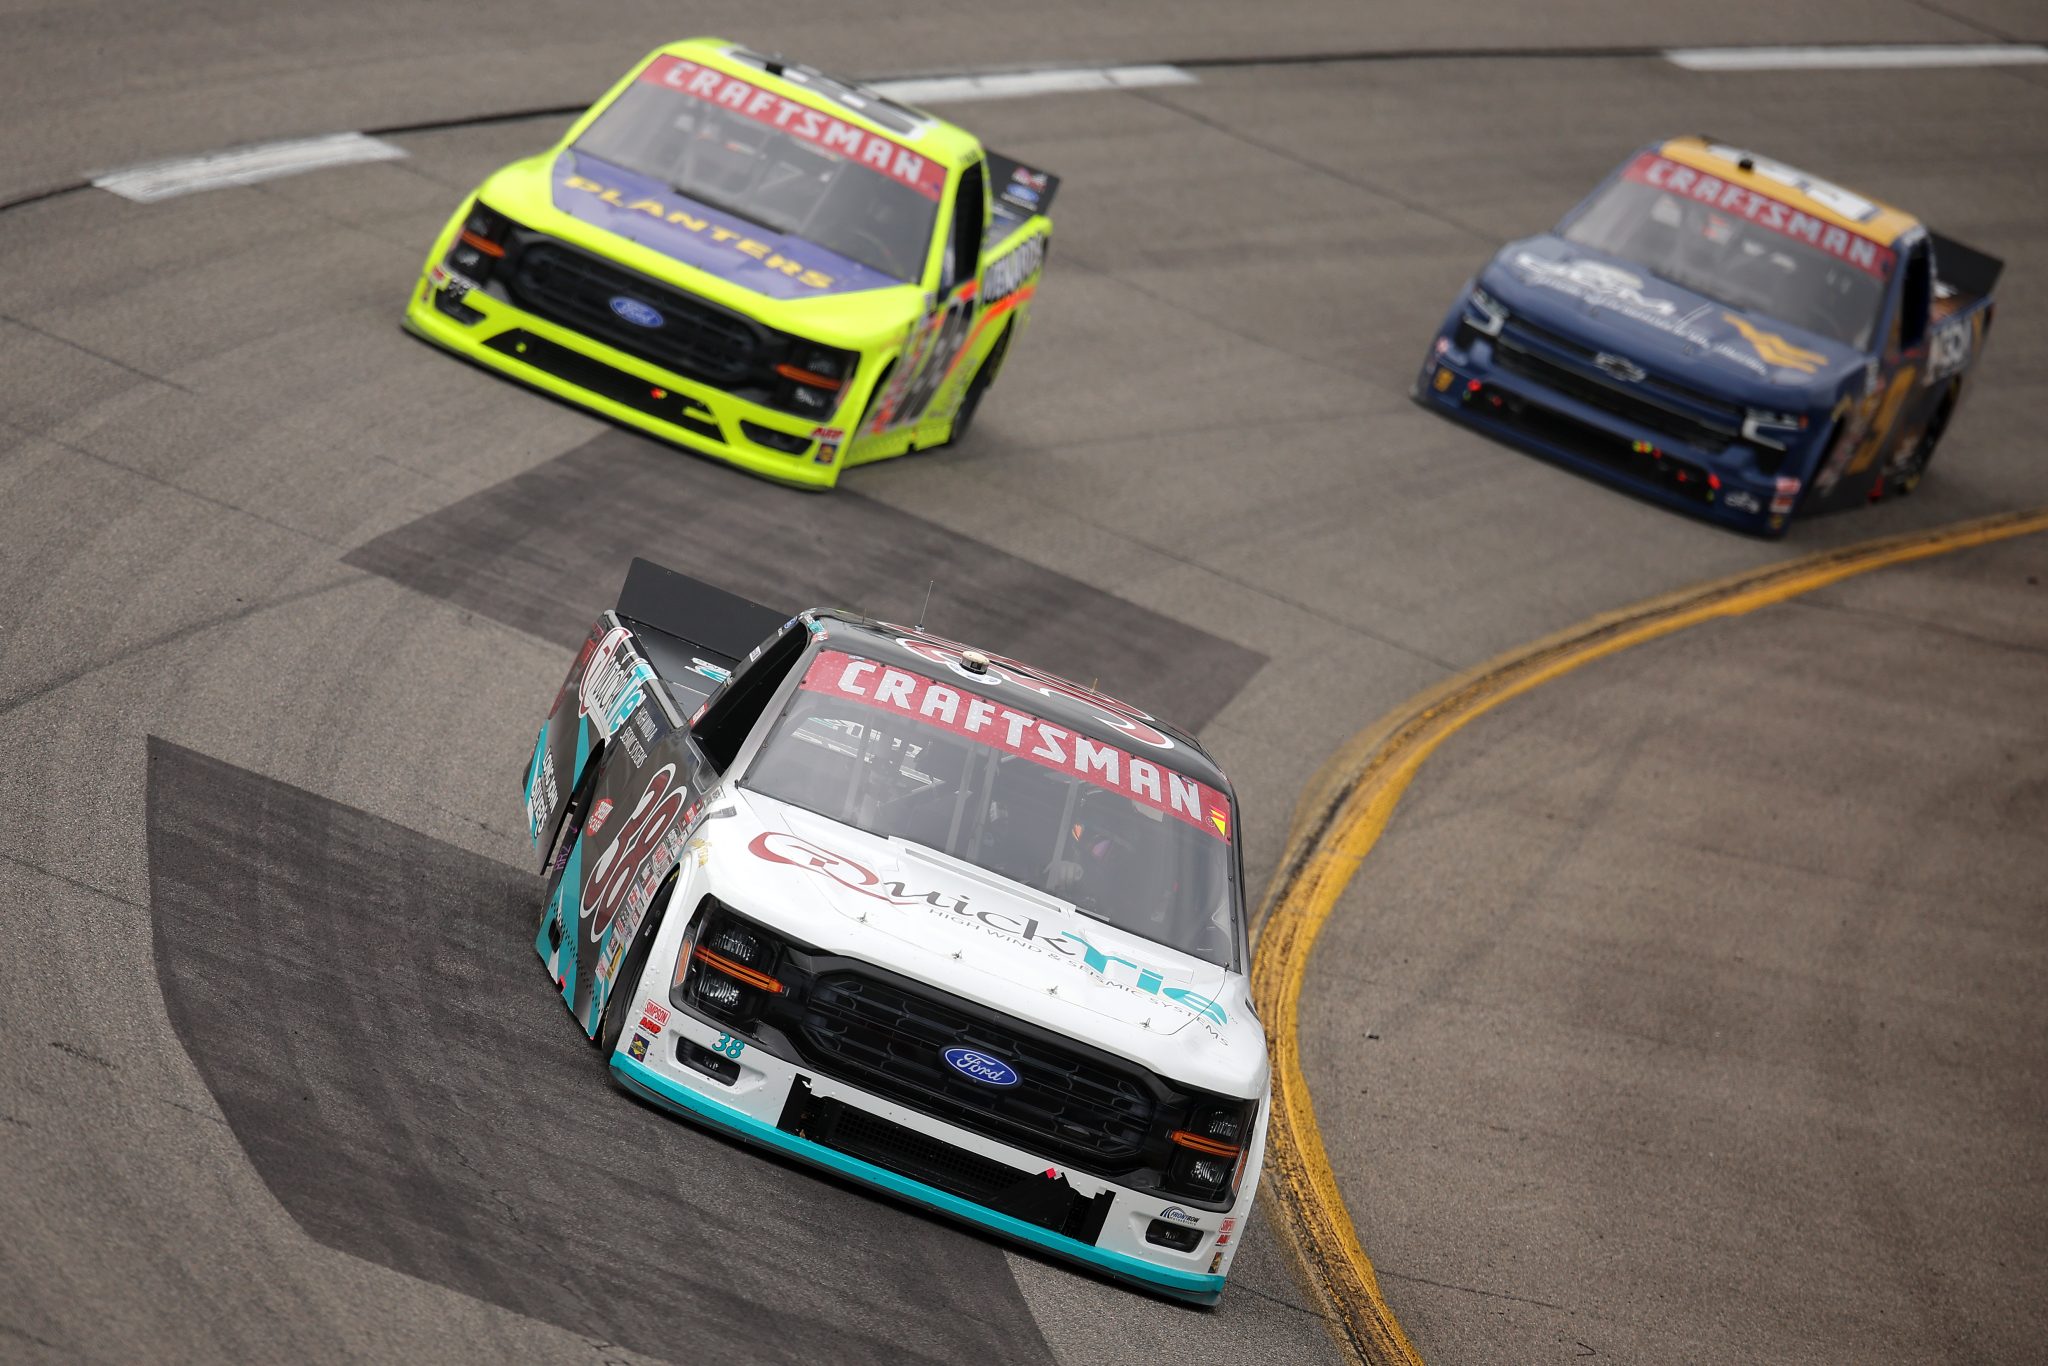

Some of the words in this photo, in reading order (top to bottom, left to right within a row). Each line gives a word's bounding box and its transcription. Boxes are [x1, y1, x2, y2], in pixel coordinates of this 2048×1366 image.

[664, 61, 925, 186] CRAFTSMAN
[563, 175, 836, 289] PLANTERS
[1645, 159, 1877, 267] CRAFTSMAN
[837, 660, 1202, 821] CRAFTSMAN
[579, 763, 687, 943] 38
[644, 1001, 669, 1025] SIMPSON
[929, 908, 980, 930] HIGH
[987, 928, 1042, 953] WIND
[1068, 960, 1145, 999] SEISMIC
[1150, 997, 1229, 1046] SYSTEMS
[712, 1031, 745, 1059] 38
[956, 1053, 1006, 1081] Ford
